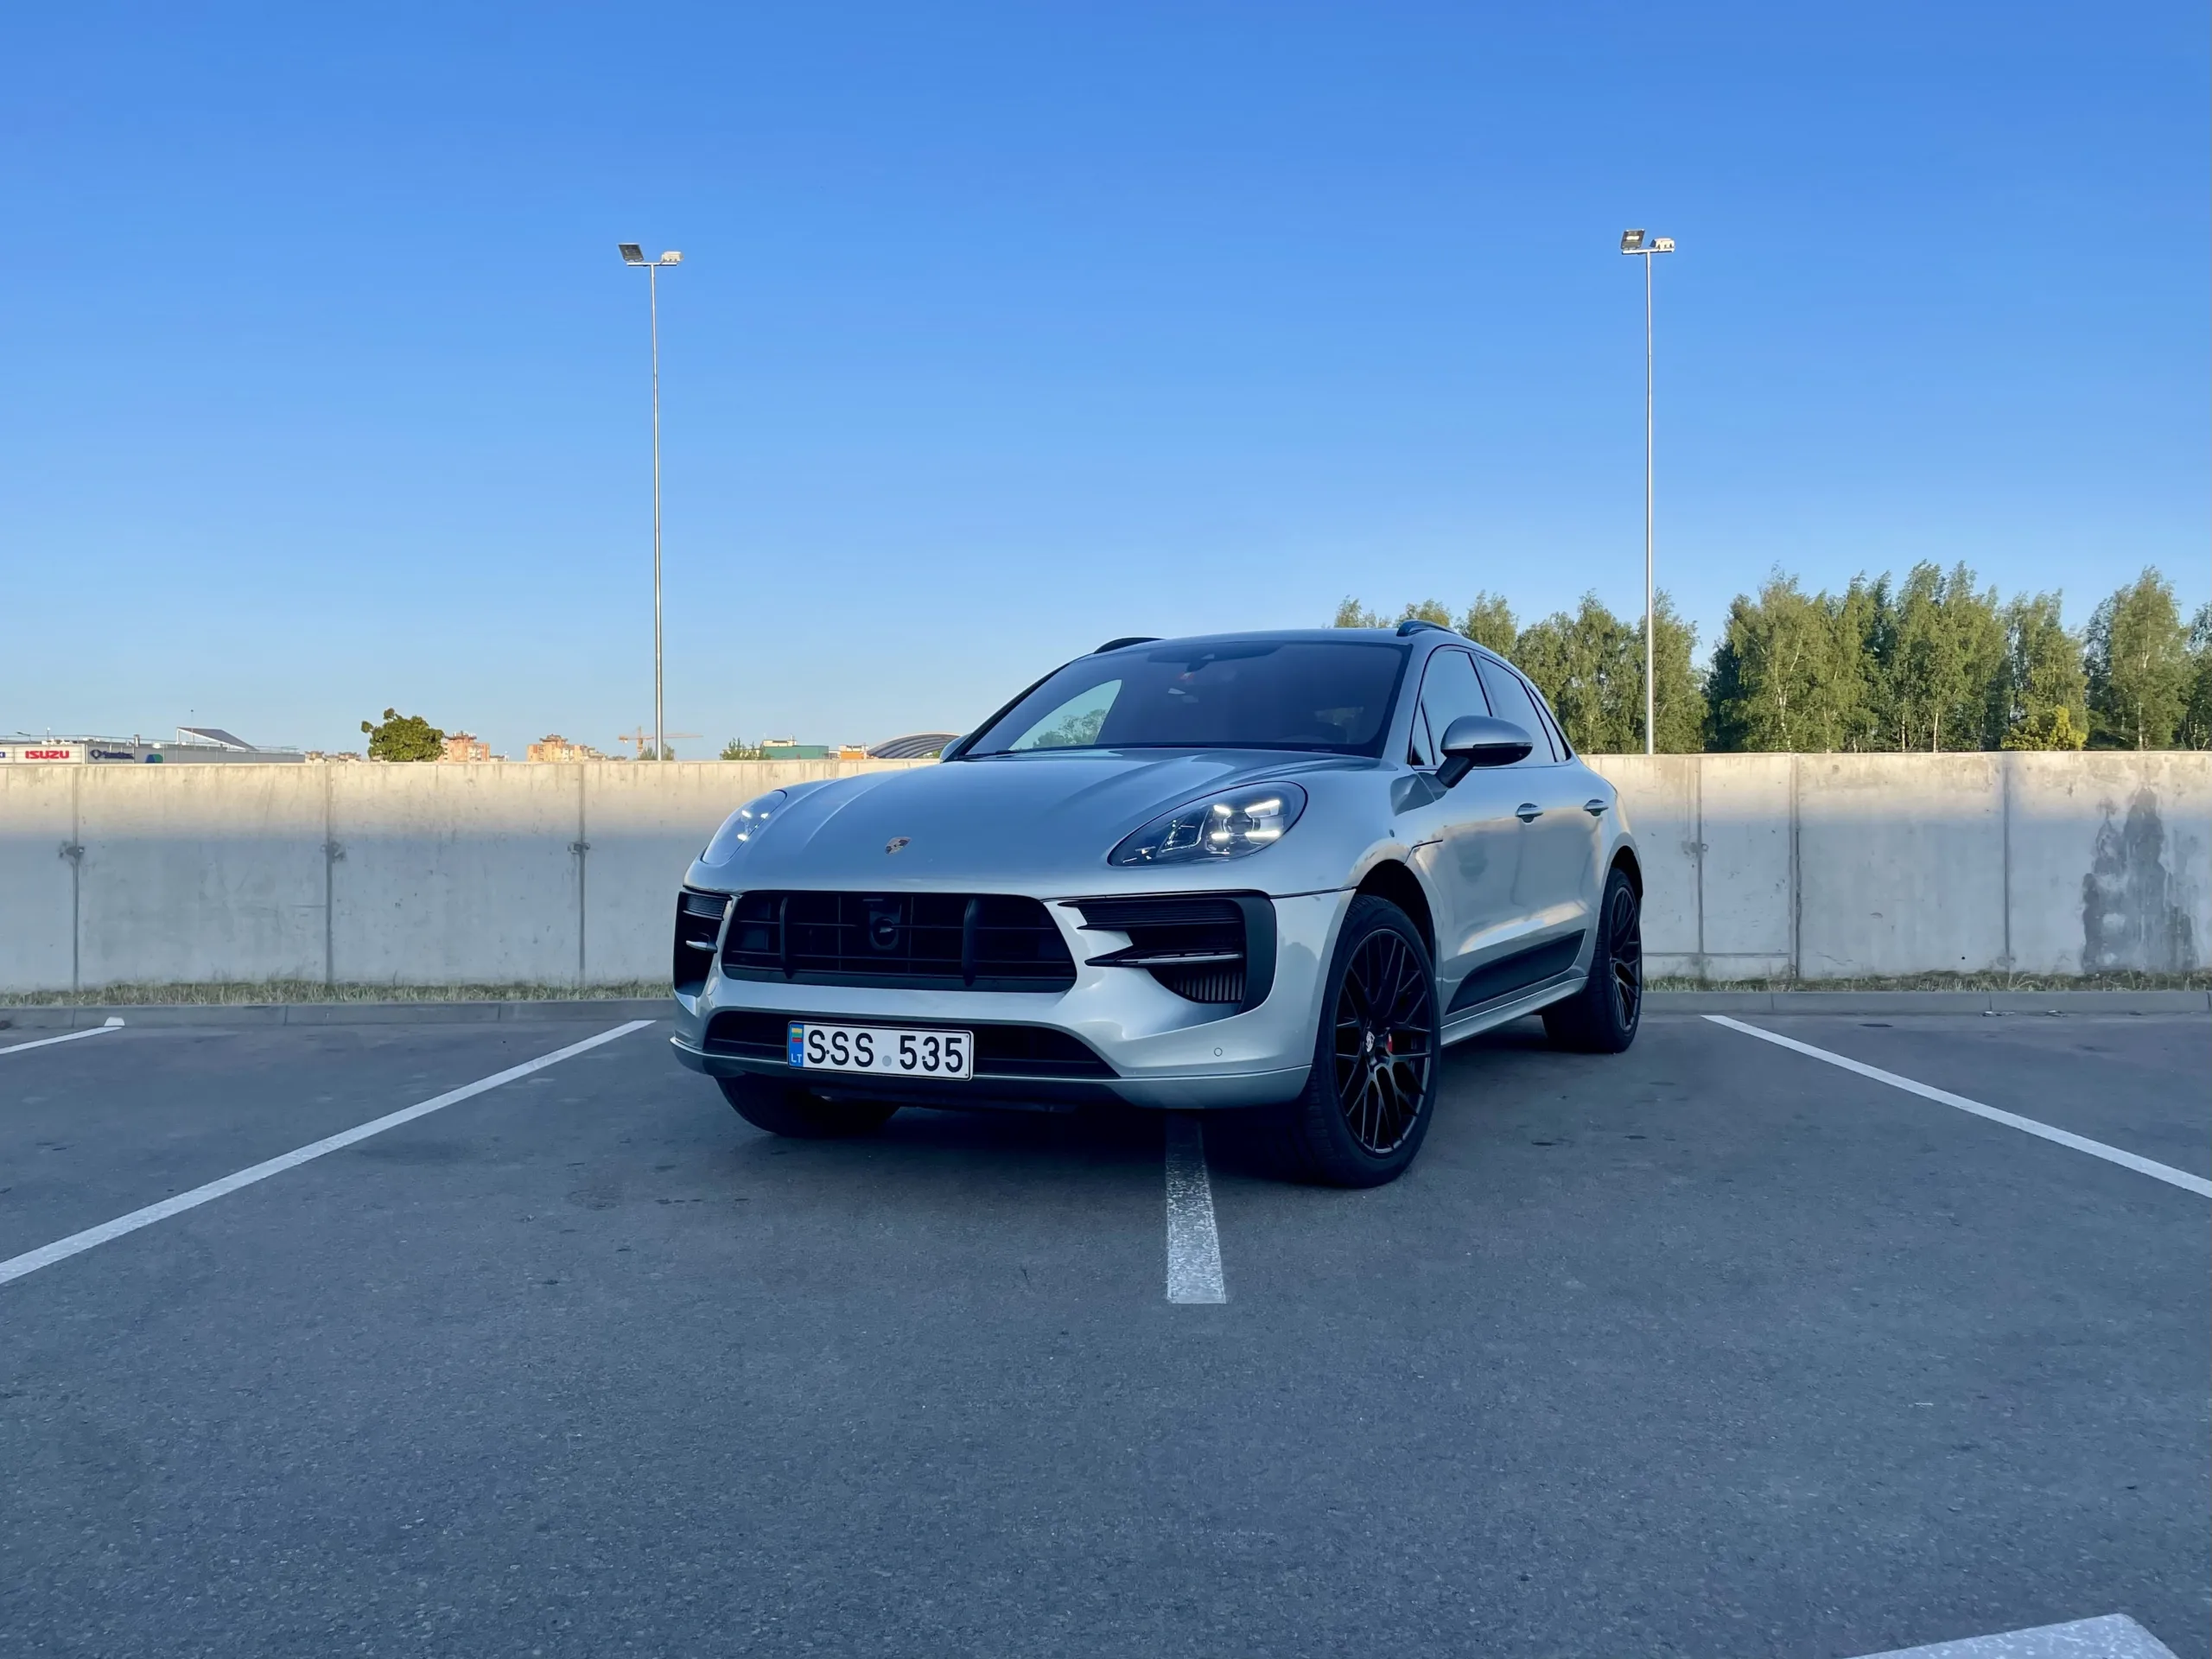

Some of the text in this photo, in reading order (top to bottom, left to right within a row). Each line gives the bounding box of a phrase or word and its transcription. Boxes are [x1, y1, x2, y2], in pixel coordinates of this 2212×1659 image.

[25, 750, 70, 760] ISUZU
[807, 1029, 963, 1073] SSS 535
[791, 1053, 803, 1064] LT
